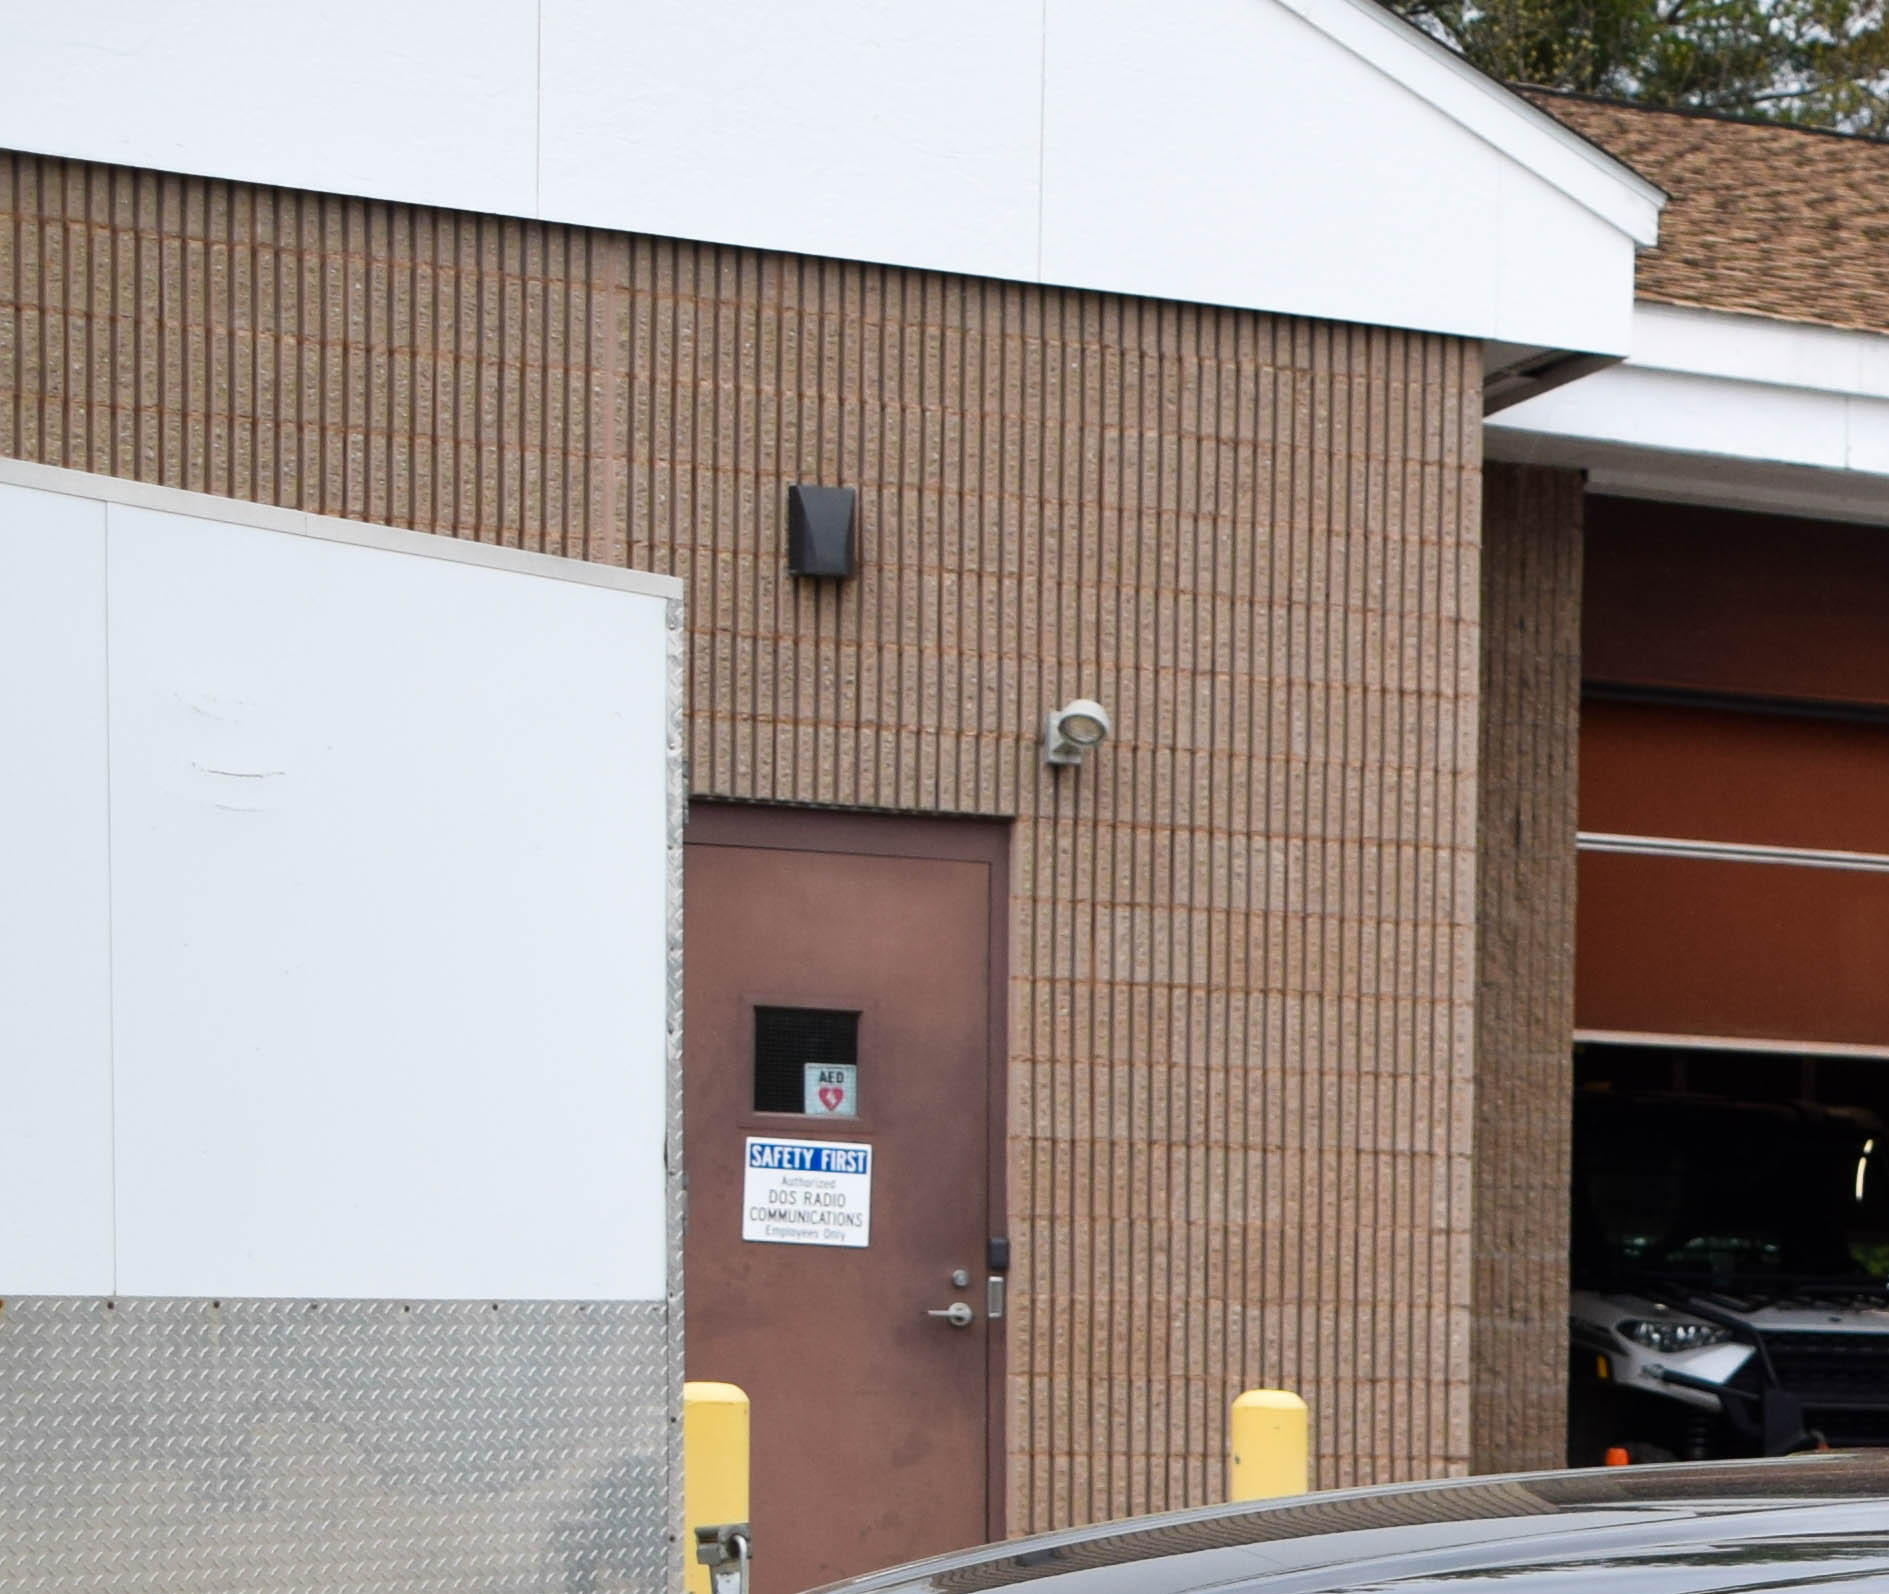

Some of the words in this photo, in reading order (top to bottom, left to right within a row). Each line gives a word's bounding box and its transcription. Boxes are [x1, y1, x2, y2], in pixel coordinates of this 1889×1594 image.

[818, 1070, 844, 1084] AED
[751, 1144, 814, 1169] SAFETY
[821, 1149, 866, 1173] FIRST
[782, 1176, 836, 1189] Authorized
[769, 1189, 797, 1205] DOS
[804, 1191, 846, 1208] RADIO
[750, 1206, 863, 1228] COMMUNICATIONS
[823, 1228, 847, 1241] Only
